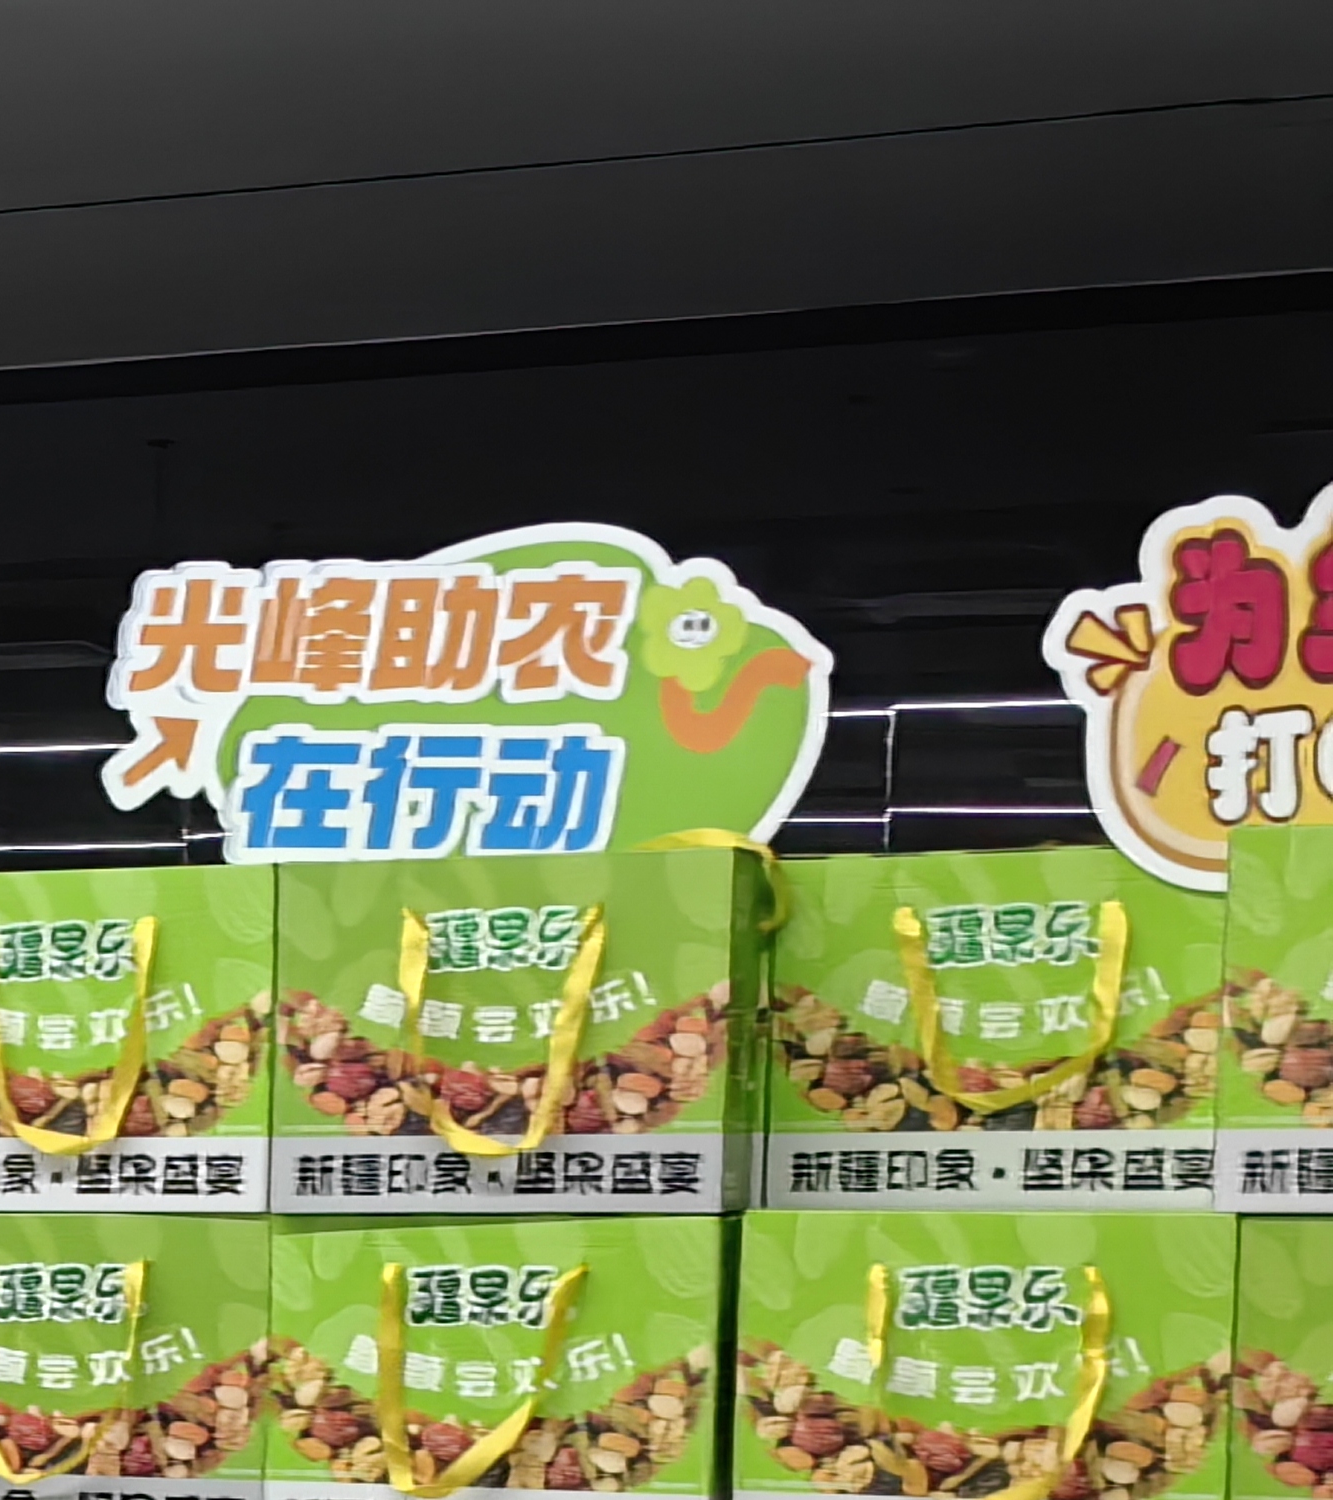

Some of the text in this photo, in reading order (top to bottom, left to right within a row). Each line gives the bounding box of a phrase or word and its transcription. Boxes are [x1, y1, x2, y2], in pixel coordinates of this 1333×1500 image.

[130, 573, 625, 694] 光峰助农
[239, 734, 612, 853] 在行动
[295, 1151, 705, 1197] 新疆印象·坚果盛宴
[790, 1148, 1214, 1194] 新疆印象·坚果盛宴
[895, 1264, 1085, 1333] 疆果乐
